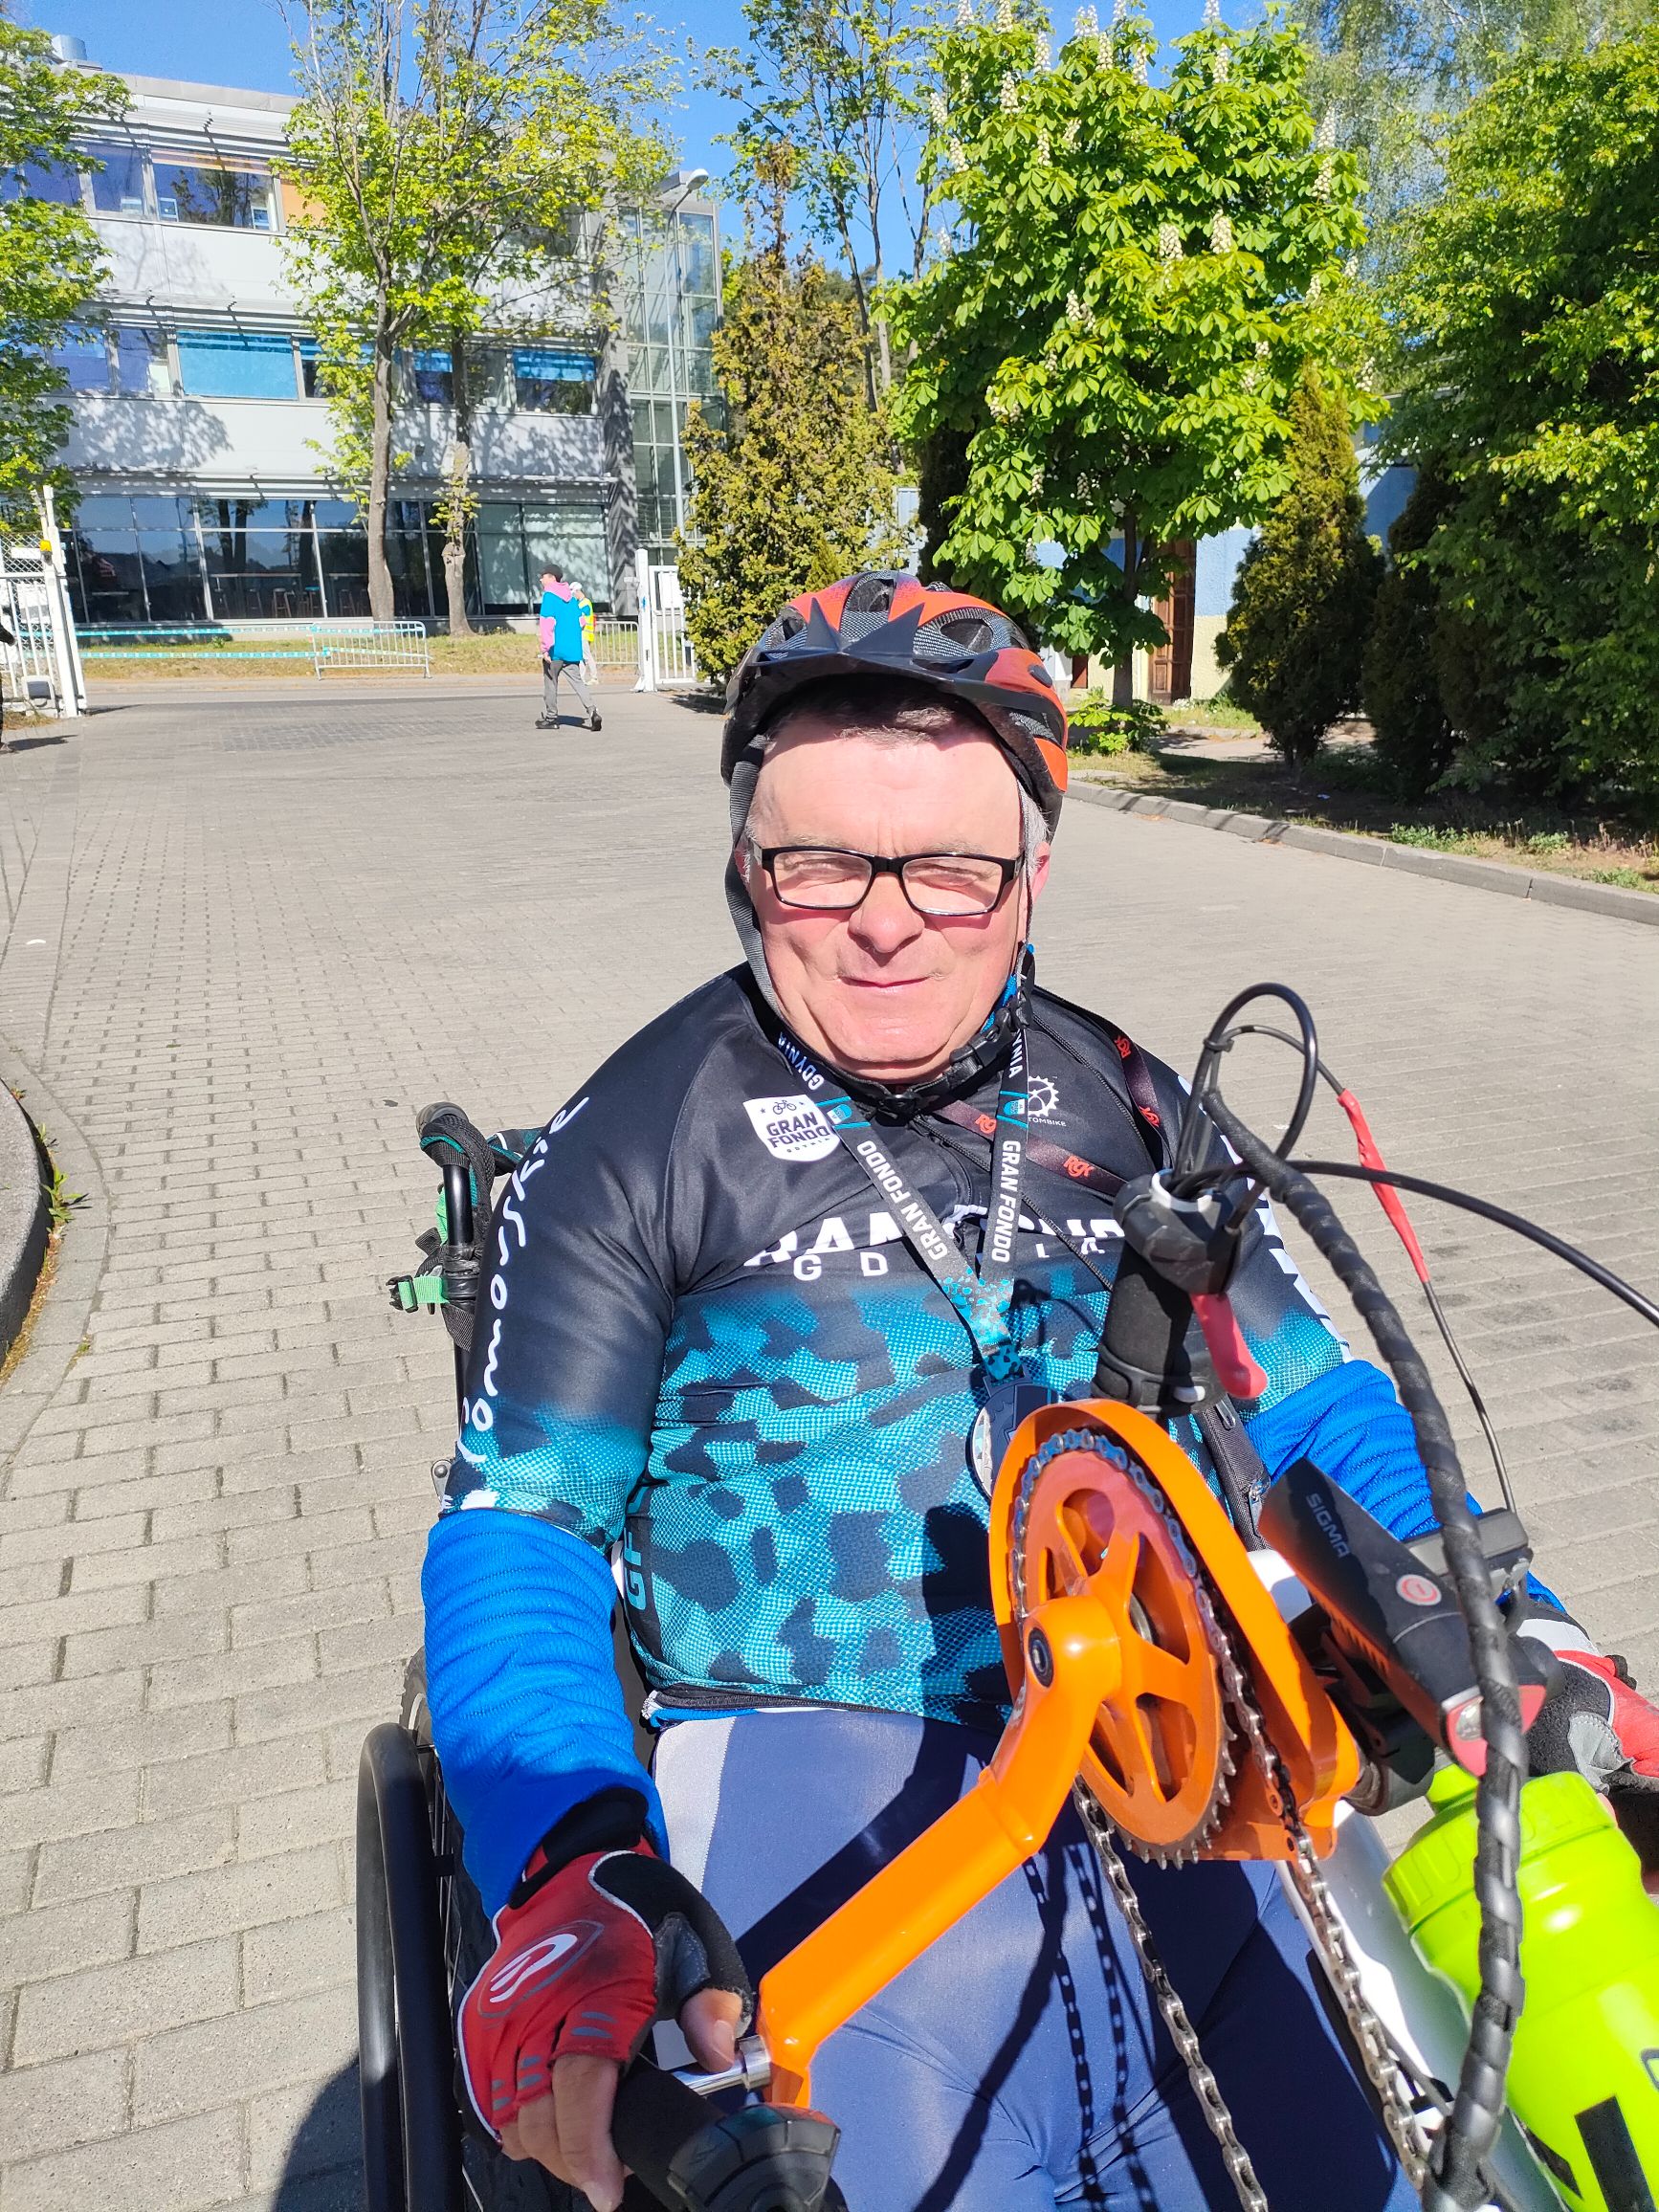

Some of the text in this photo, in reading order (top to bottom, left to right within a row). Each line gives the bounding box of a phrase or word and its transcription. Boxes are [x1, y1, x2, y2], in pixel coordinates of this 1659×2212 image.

[777, 1031, 825, 1091] GDYNIA
[1008, 1028, 1025, 1078] YNIA
[765, 1111, 819, 1137] GRAN
[766, 1125, 830, 1149] FONDO
[1000, 1139, 1022, 1193] GRAN
[856, 1139, 949, 1261] GRAN FONDO
[990, 1192, 1017, 1263] FONDO
[1305, 1493, 1350, 1558] SIGMA
